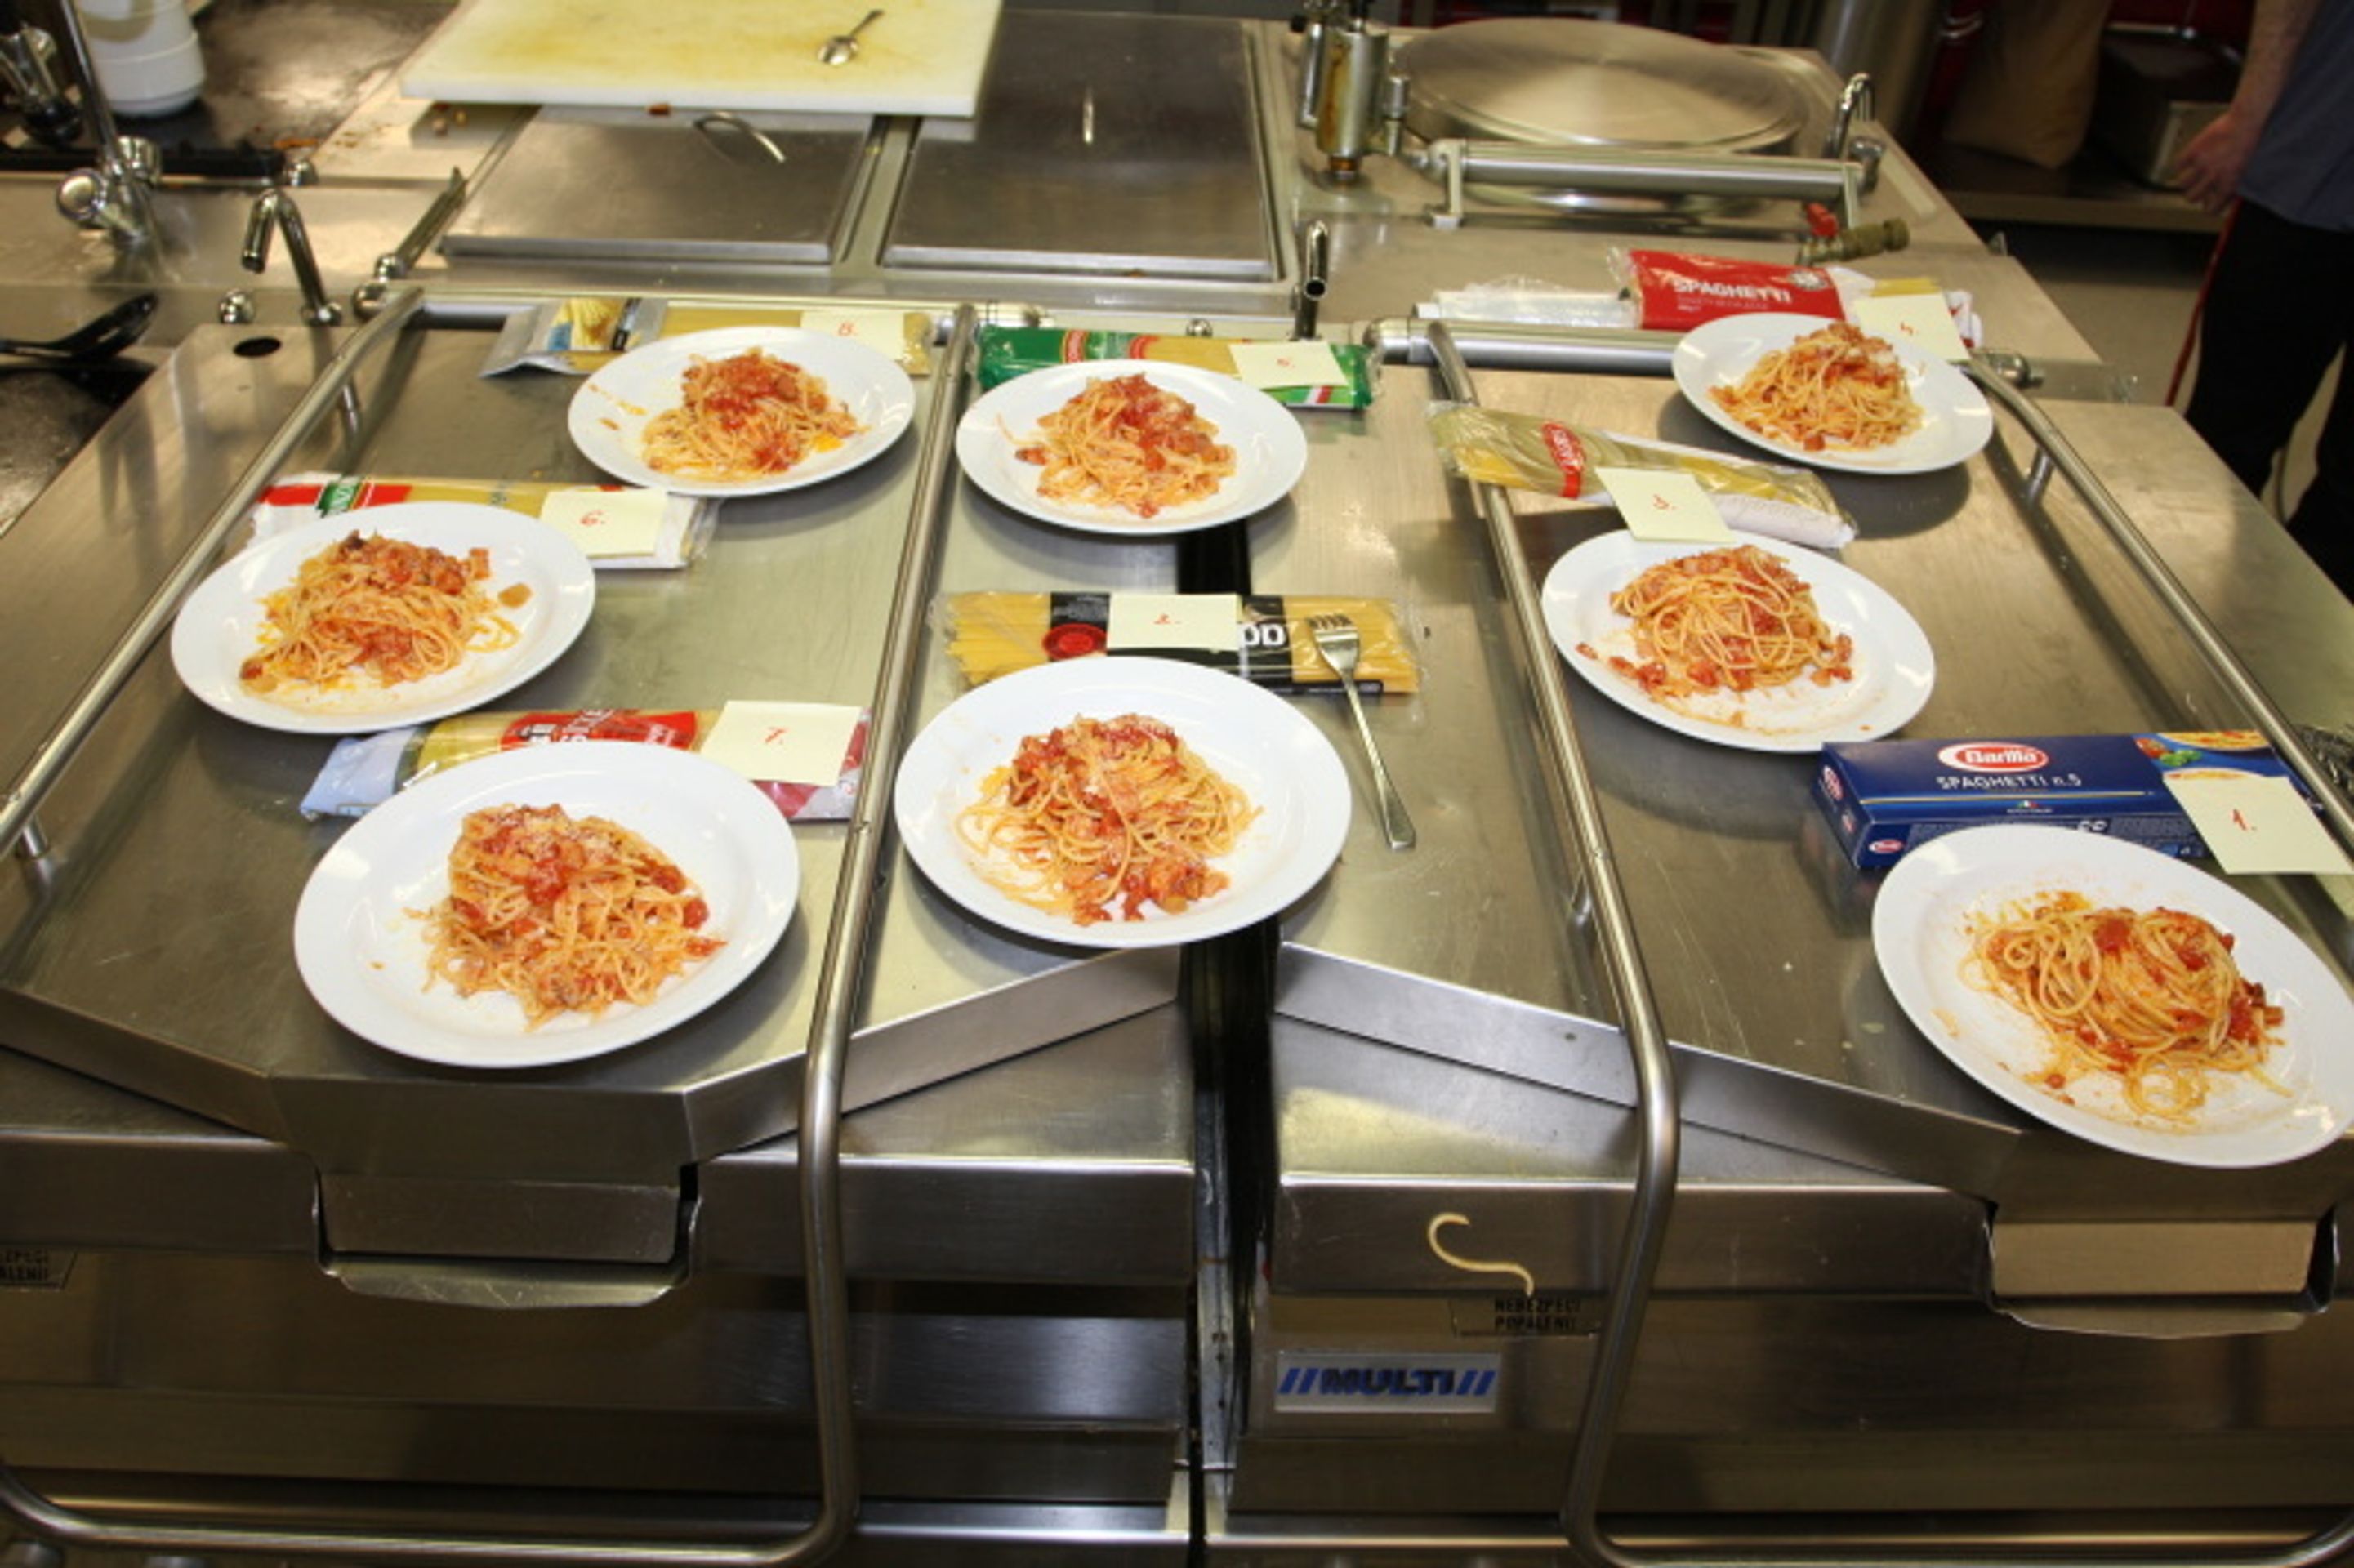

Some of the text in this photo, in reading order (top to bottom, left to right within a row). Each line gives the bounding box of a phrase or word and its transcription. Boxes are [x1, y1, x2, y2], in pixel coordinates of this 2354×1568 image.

[1676, 279, 1792, 304] SPAGHETTI
[1937, 776, 2049, 790] SPAGHETTI
[1318, 1368, 1456, 1396] MULTI
